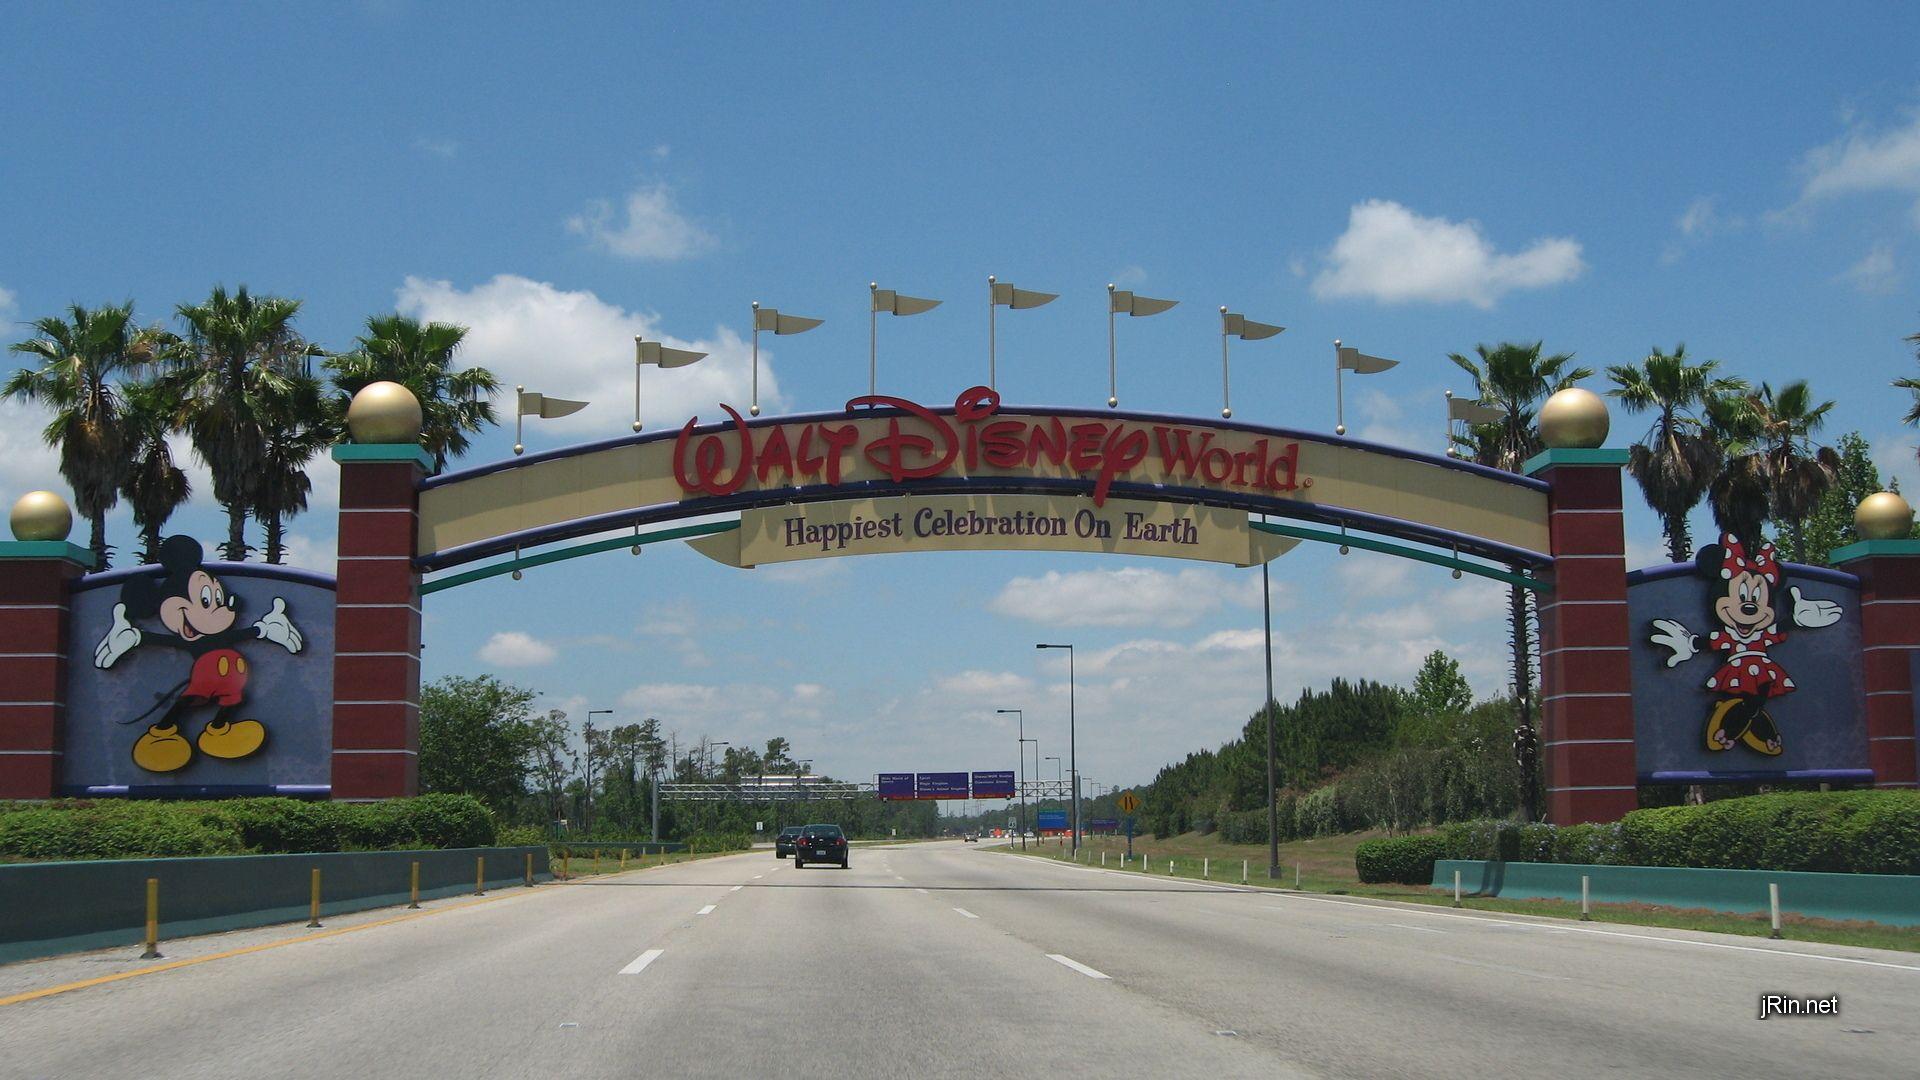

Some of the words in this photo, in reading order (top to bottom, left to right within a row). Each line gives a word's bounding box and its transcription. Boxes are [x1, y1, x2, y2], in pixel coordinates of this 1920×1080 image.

[784, 511, 904, 551] Happiest
[913, 507, 1068, 538] Celebration
[1074, 508, 1112, 539] On
[1122, 511, 1199, 545] Earth
